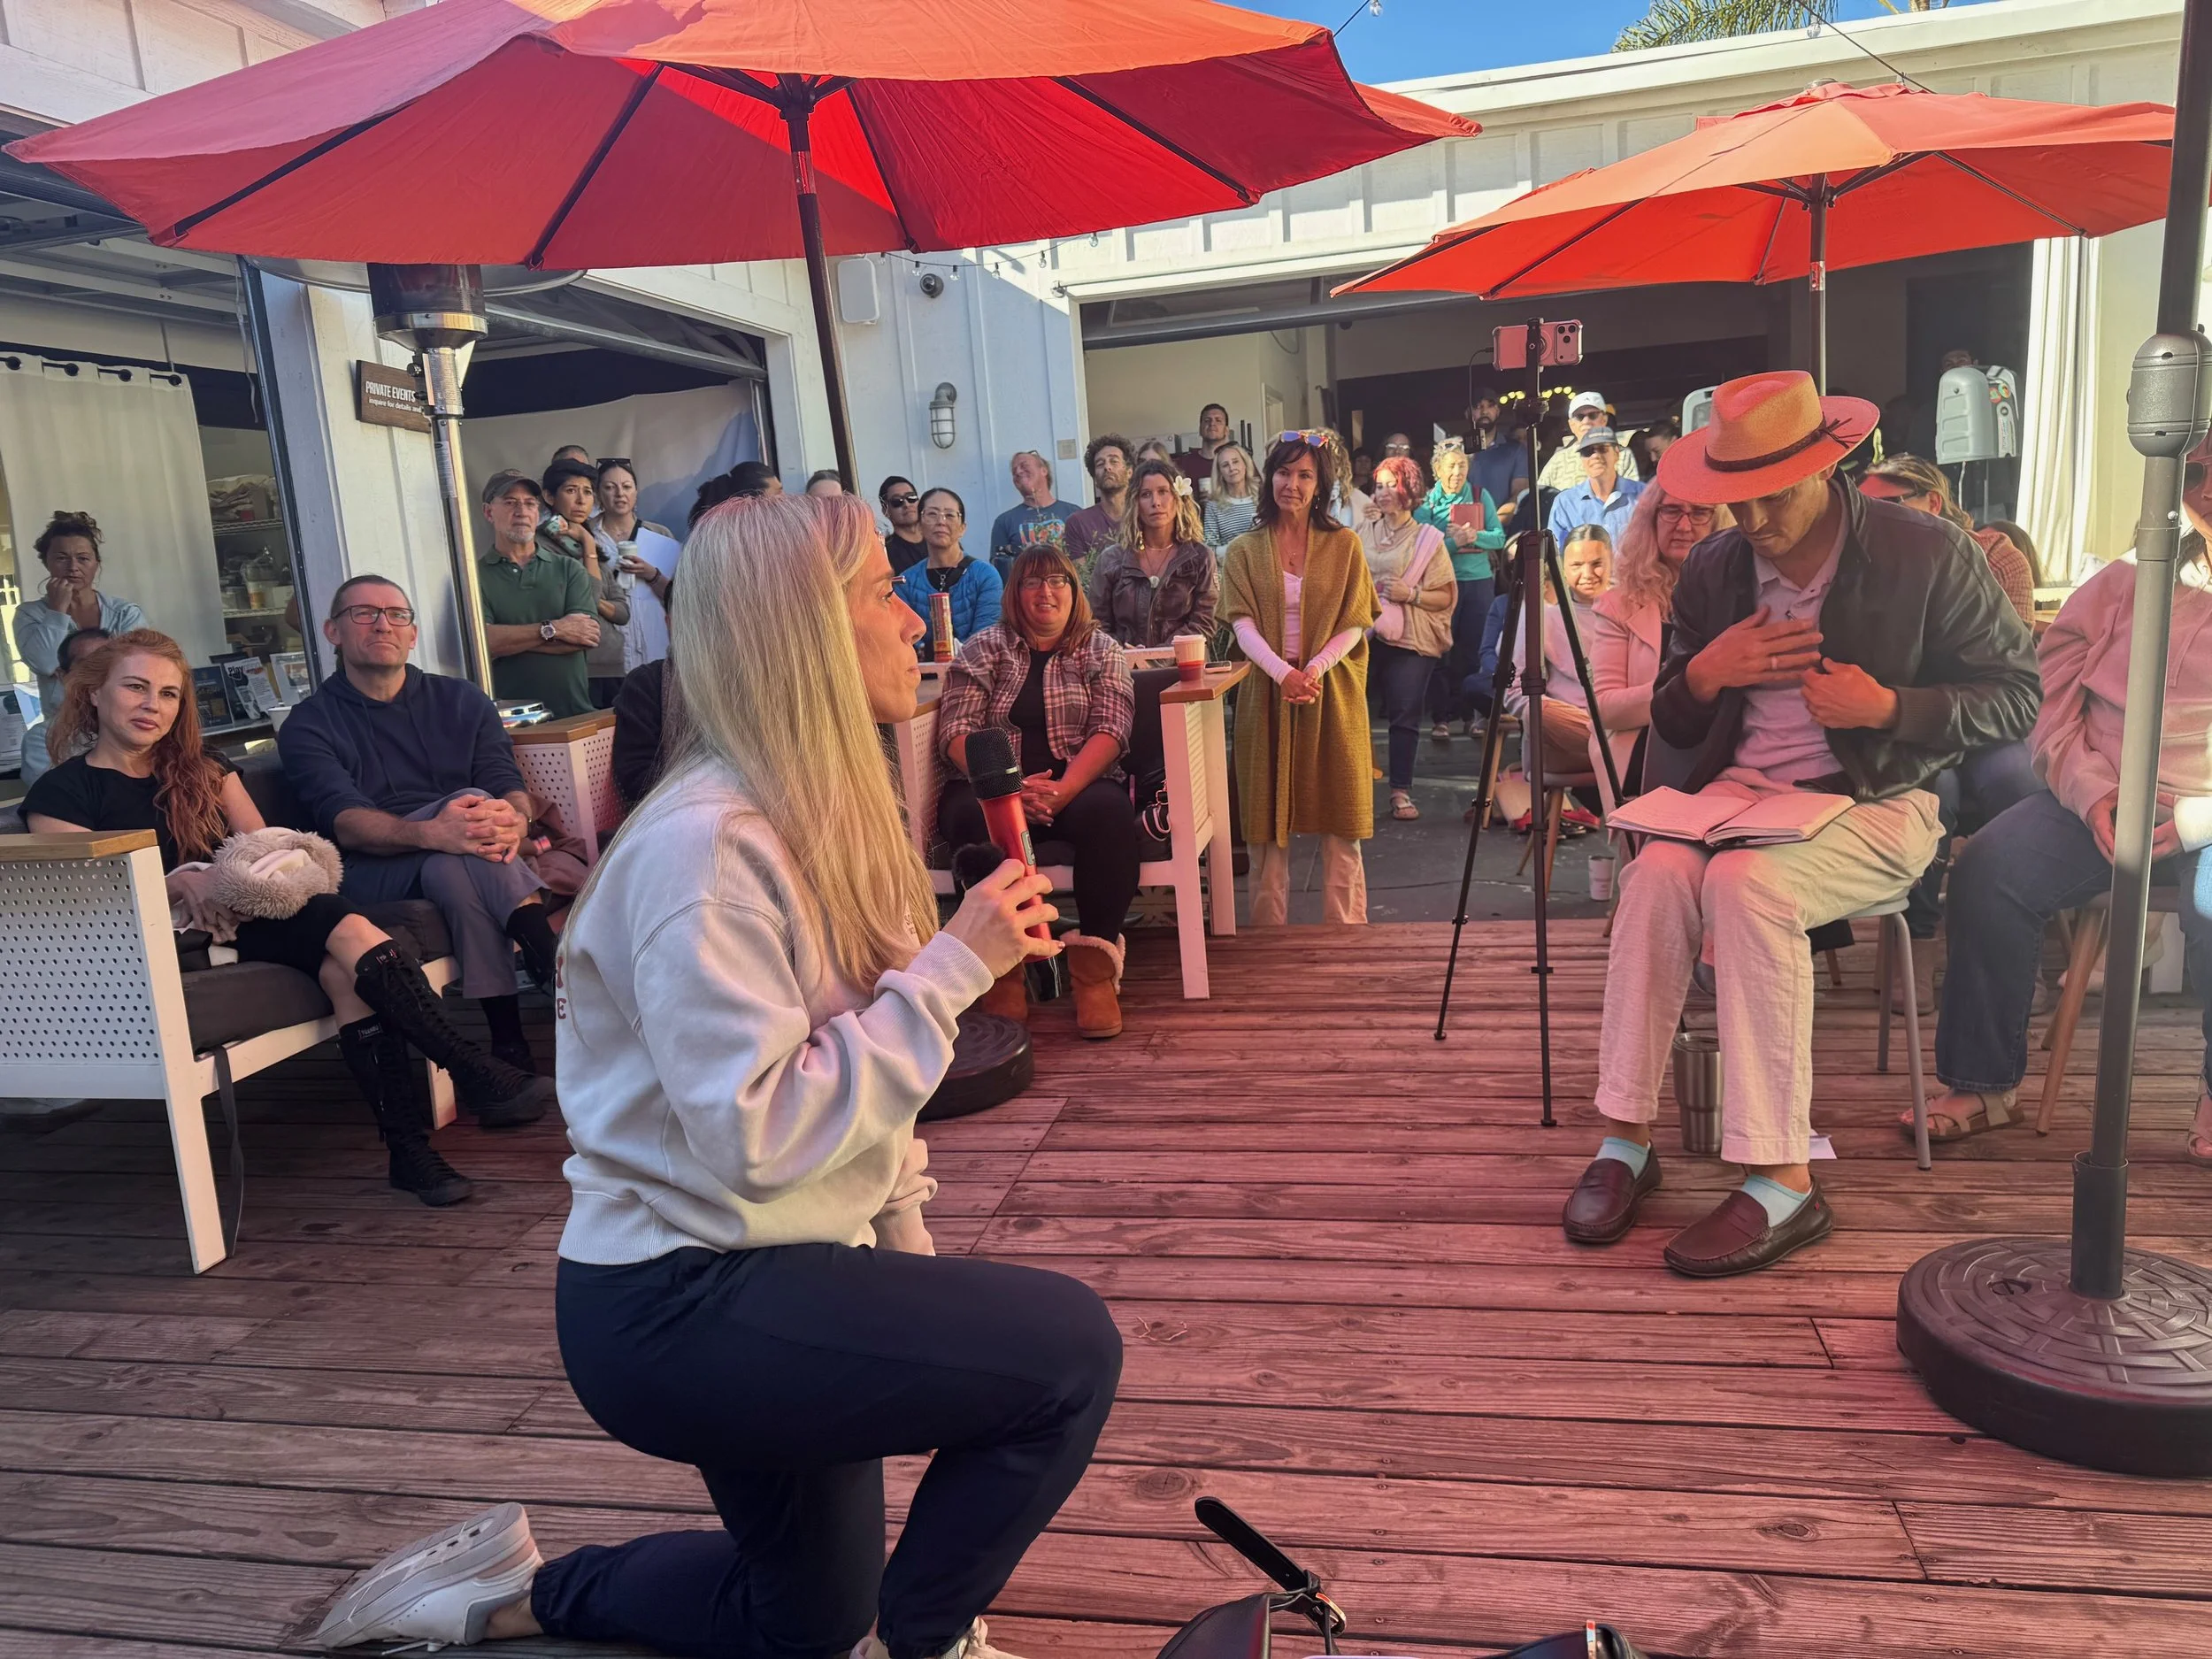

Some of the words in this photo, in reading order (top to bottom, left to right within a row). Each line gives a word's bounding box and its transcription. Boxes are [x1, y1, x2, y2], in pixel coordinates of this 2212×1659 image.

[365, 381, 391, 398] PRIVATE
[392, 386, 416, 403] EVENTS
[369, 397, 387, 407] inquire
[396, 403, 411, 411] details
